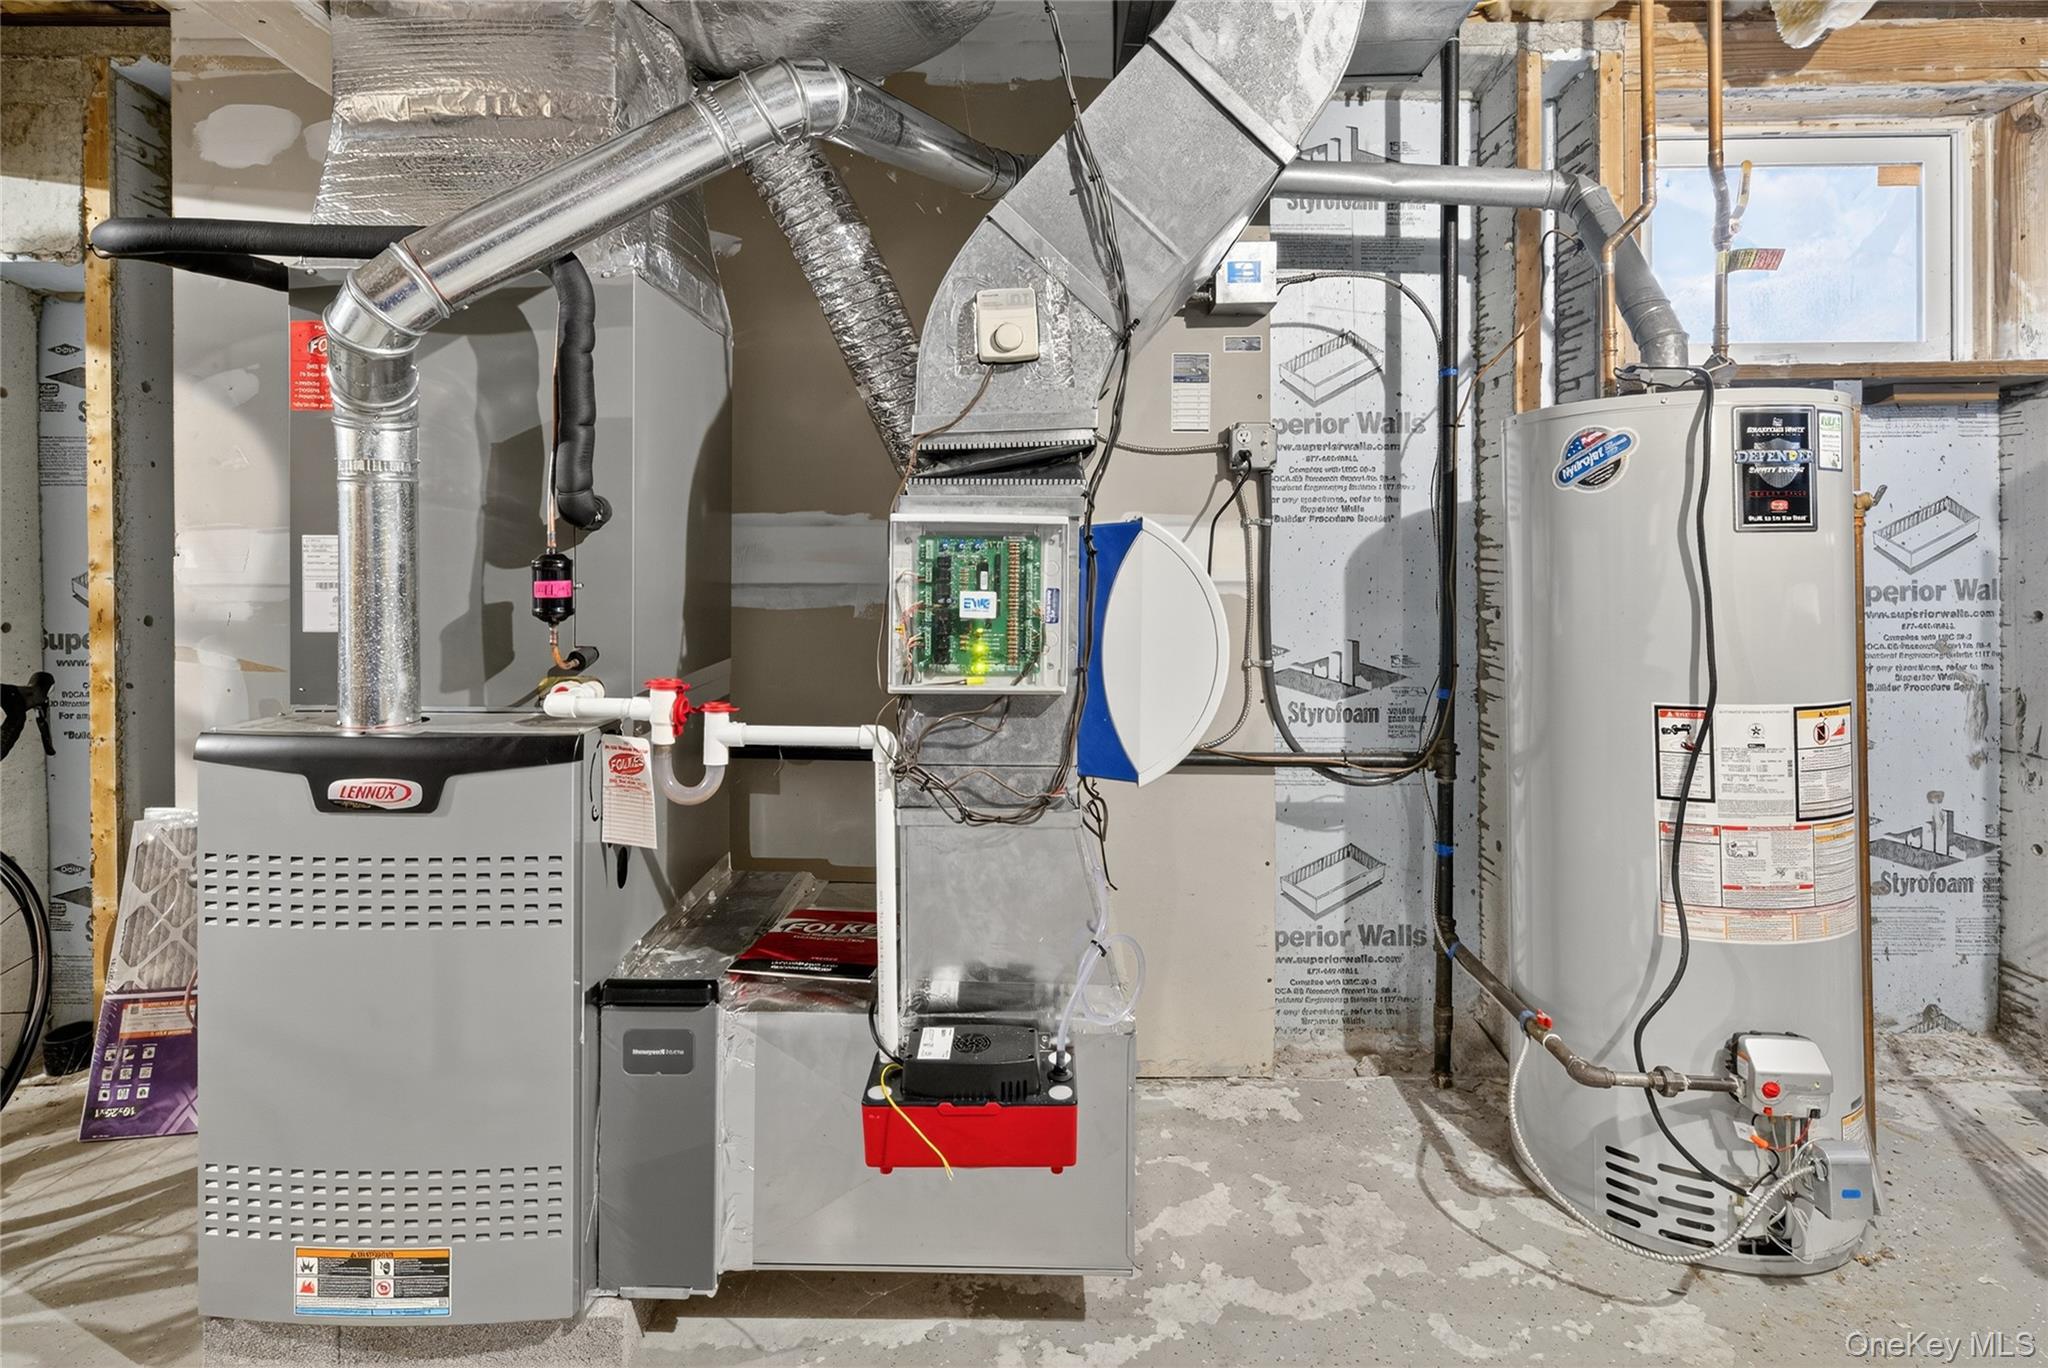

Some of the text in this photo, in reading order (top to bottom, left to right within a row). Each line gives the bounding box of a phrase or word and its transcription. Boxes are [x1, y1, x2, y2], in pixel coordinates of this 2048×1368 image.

[1356, 411, 1426, 435] Walls
[1735, 449, 1813, 464] DEFENDER
[1287, 700, 1380, 727] Styrofoam
[339, 785, 397, 800] LENNOX
[1880, 870, 1975, 897] Styrofoam
[1357, 923, 1428, 947] Walls
